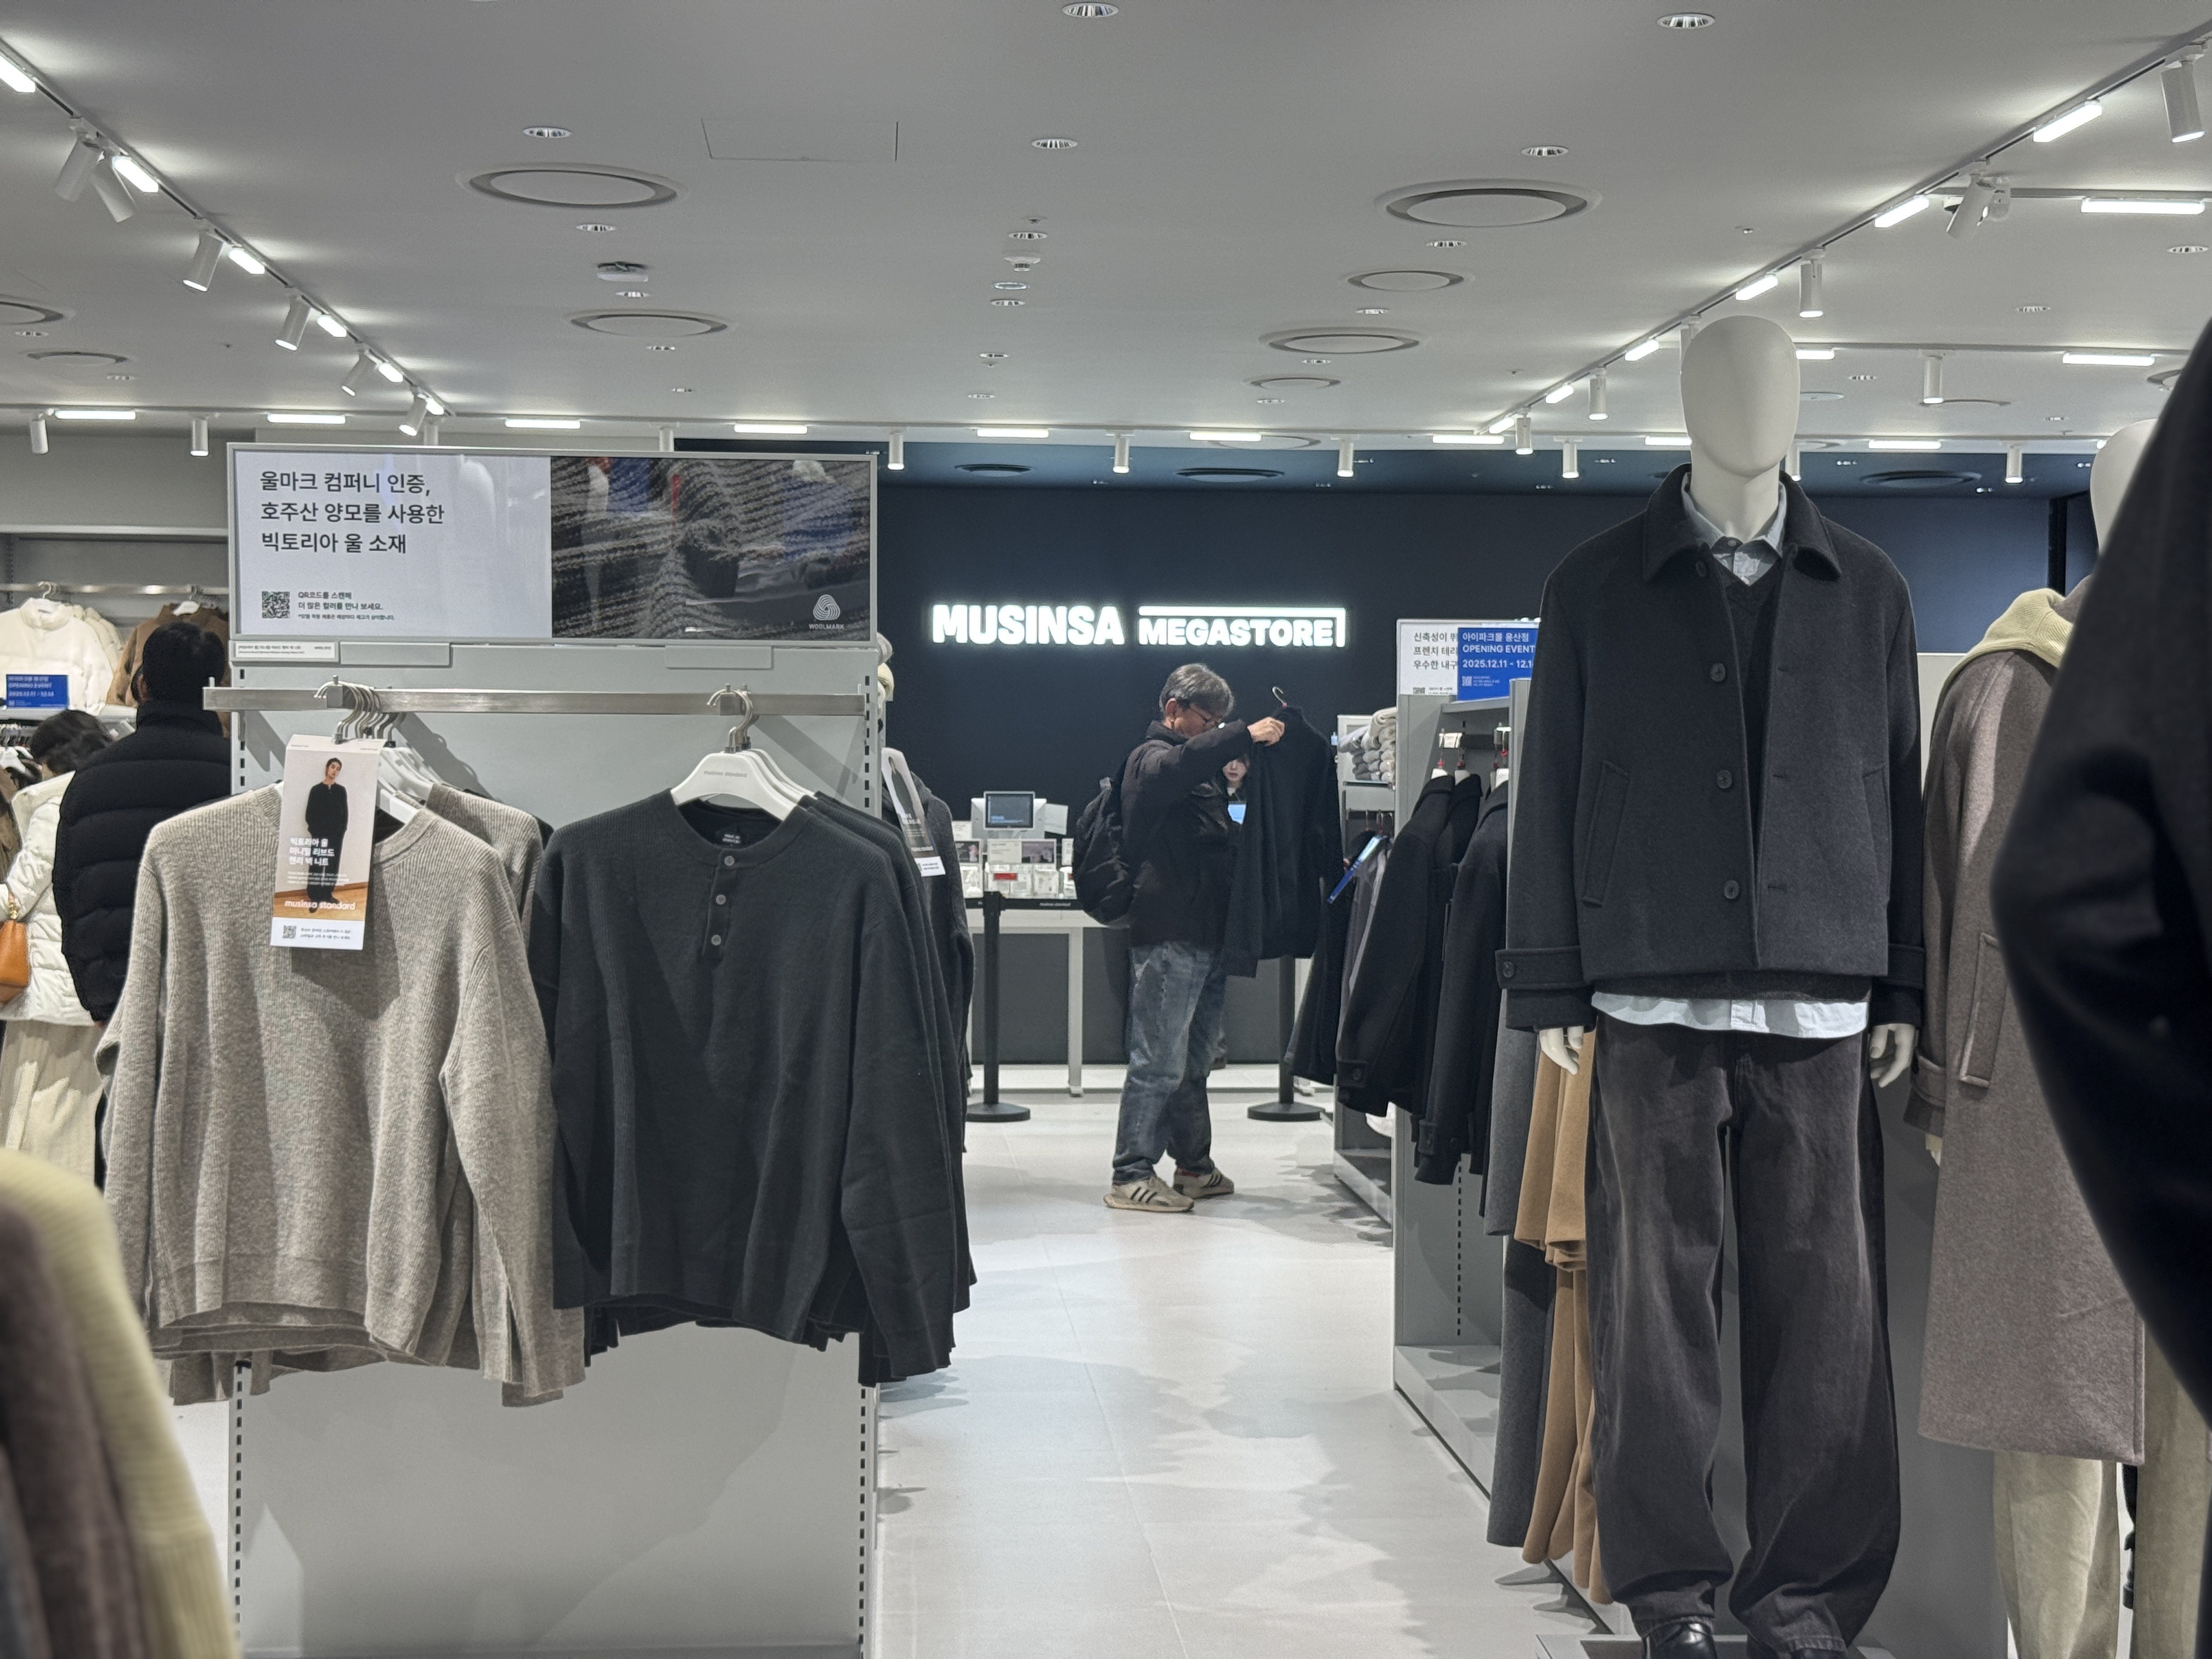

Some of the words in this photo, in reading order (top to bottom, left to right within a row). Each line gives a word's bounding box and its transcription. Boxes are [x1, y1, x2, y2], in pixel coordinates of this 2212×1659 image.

[260, 471, 318, 492] 울마크
[324, 472, 380, 493] 컴퍼니
[387, 473, 430, 496] 인증,
[261, 502, 319, 522] 호주산
[325, 503, 382, 523] 양모를
[387, 504, 445, 524] 사용한
[262, 532, 339, 553] 빅토리아
[344, 533, 363, 554] 울
[369, 534, 406, 554] 소재
[932, 604, 1126, 645] MUSINSA
[1138, 618, 1334, 647] MEGASTORE
[1413, 632, 1448, 642] 신축성이
[1462, 632, 1503, 642] 아이파크몰
[1504, 632, 1530, 642] 용산점
[1413, 646, 1439, 656] 프렌치
[1462, 645, 1503, 653] OPENING
[1505, 645, 1536, 653] EVENT
[1413, 660, 1439, 670] 우수한
[1462, 659, 1507, 668] 2025.12.11
[314, 857, 329, 866] 니트
[284, 899, 318, 909] musinsa
[319, 901, 356, 910] standard
